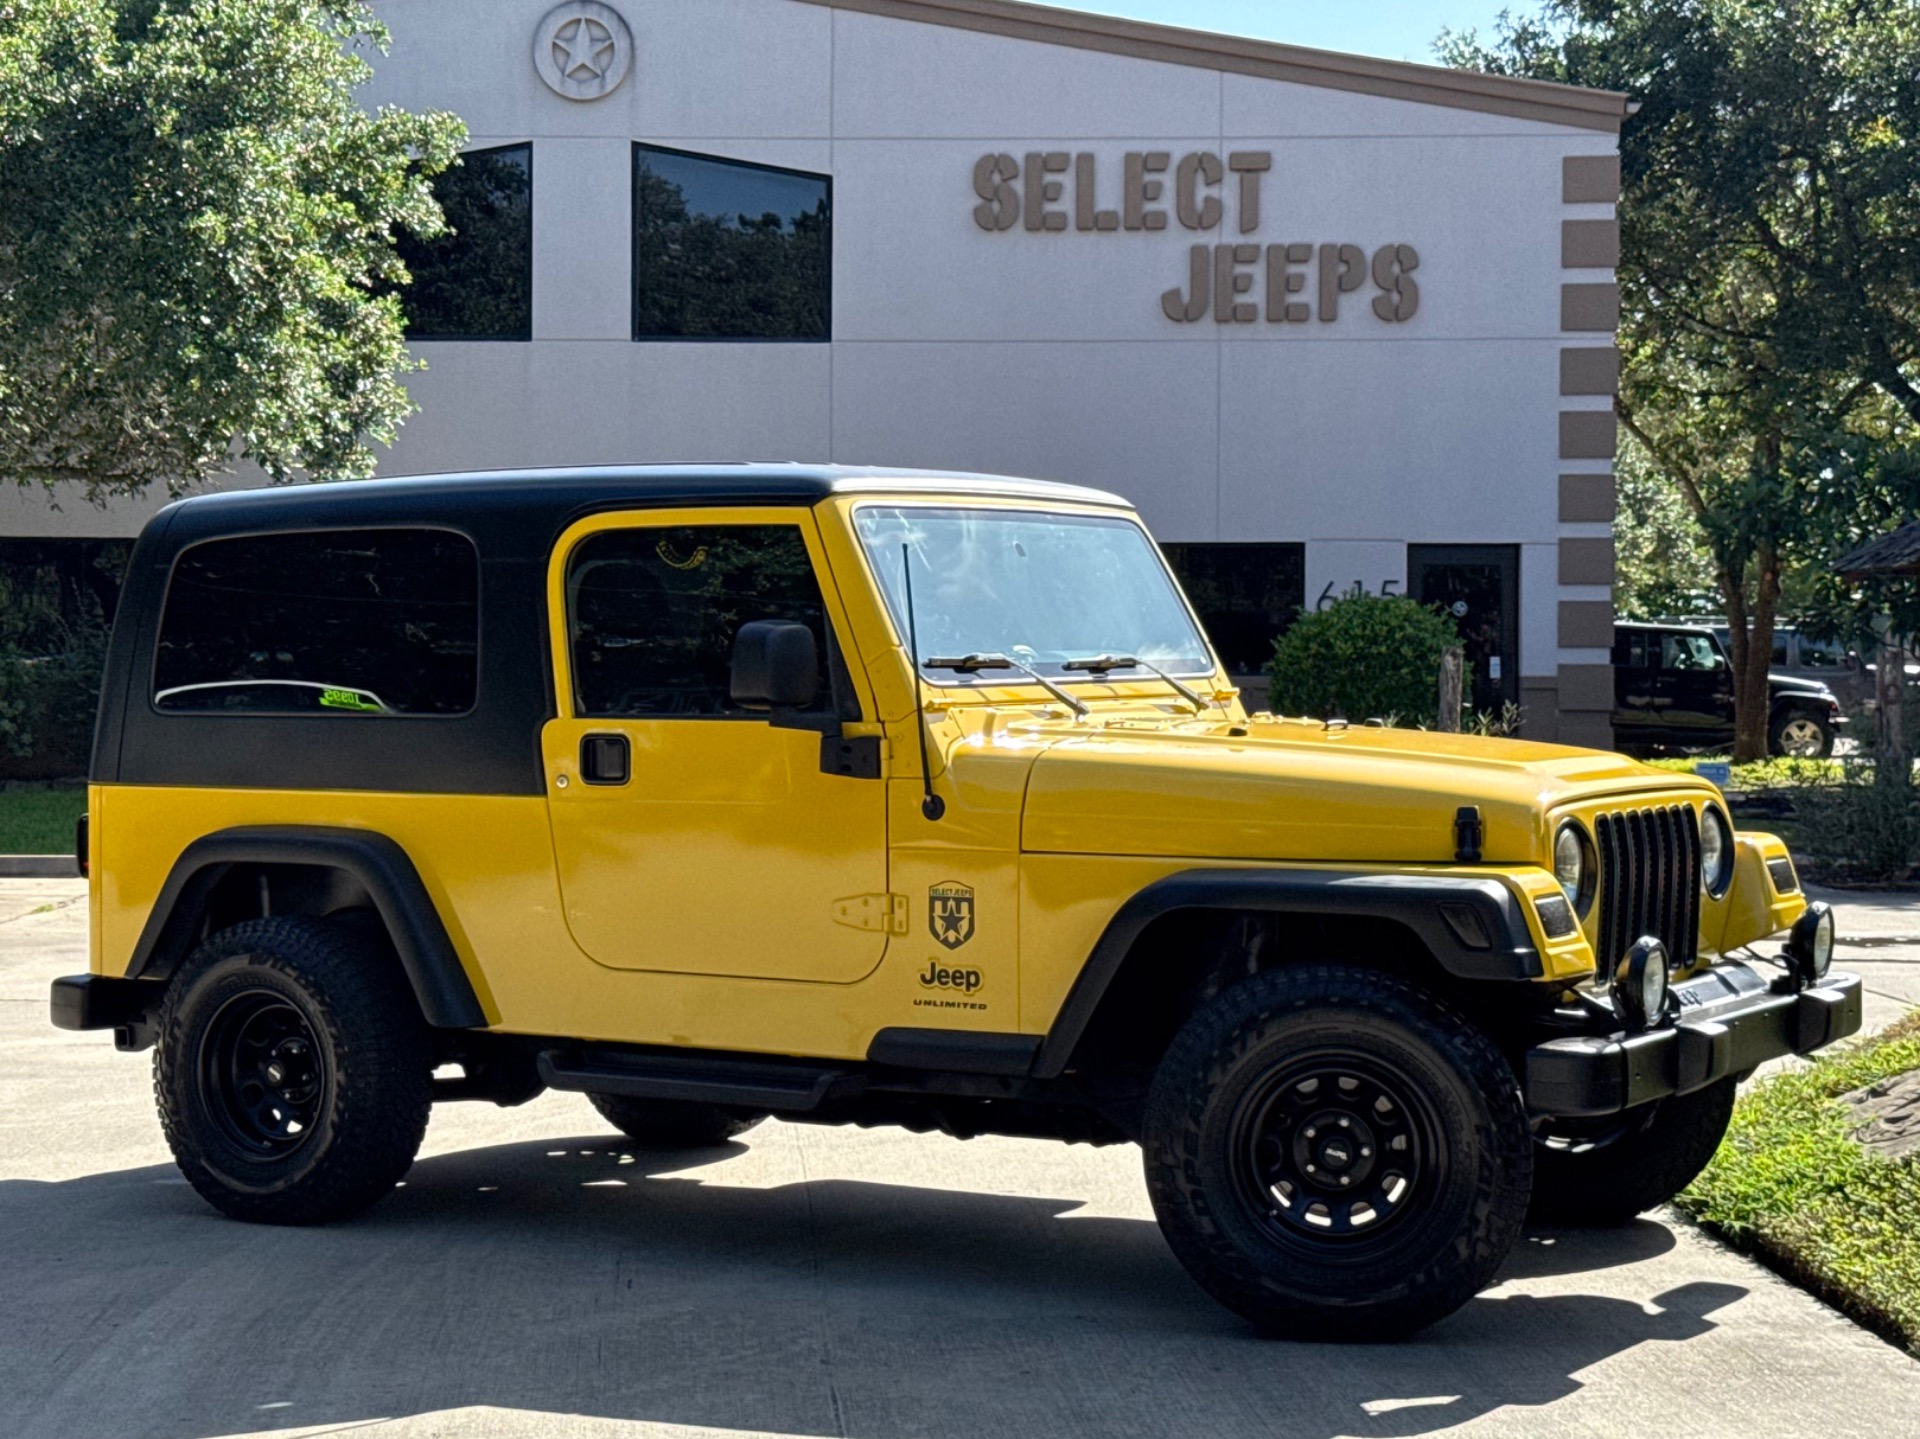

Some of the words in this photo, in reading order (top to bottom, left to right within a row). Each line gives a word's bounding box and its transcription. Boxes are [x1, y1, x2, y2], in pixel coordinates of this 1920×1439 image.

[972, 152, 1272, 233] SELECT
[1160, 243, 1420, 322] JEEPS
[932, 888, 952, 896] SELECT
[920, 961, 980, 992] Jeep
[913, 999, 987, 1010] UNLIMITED
